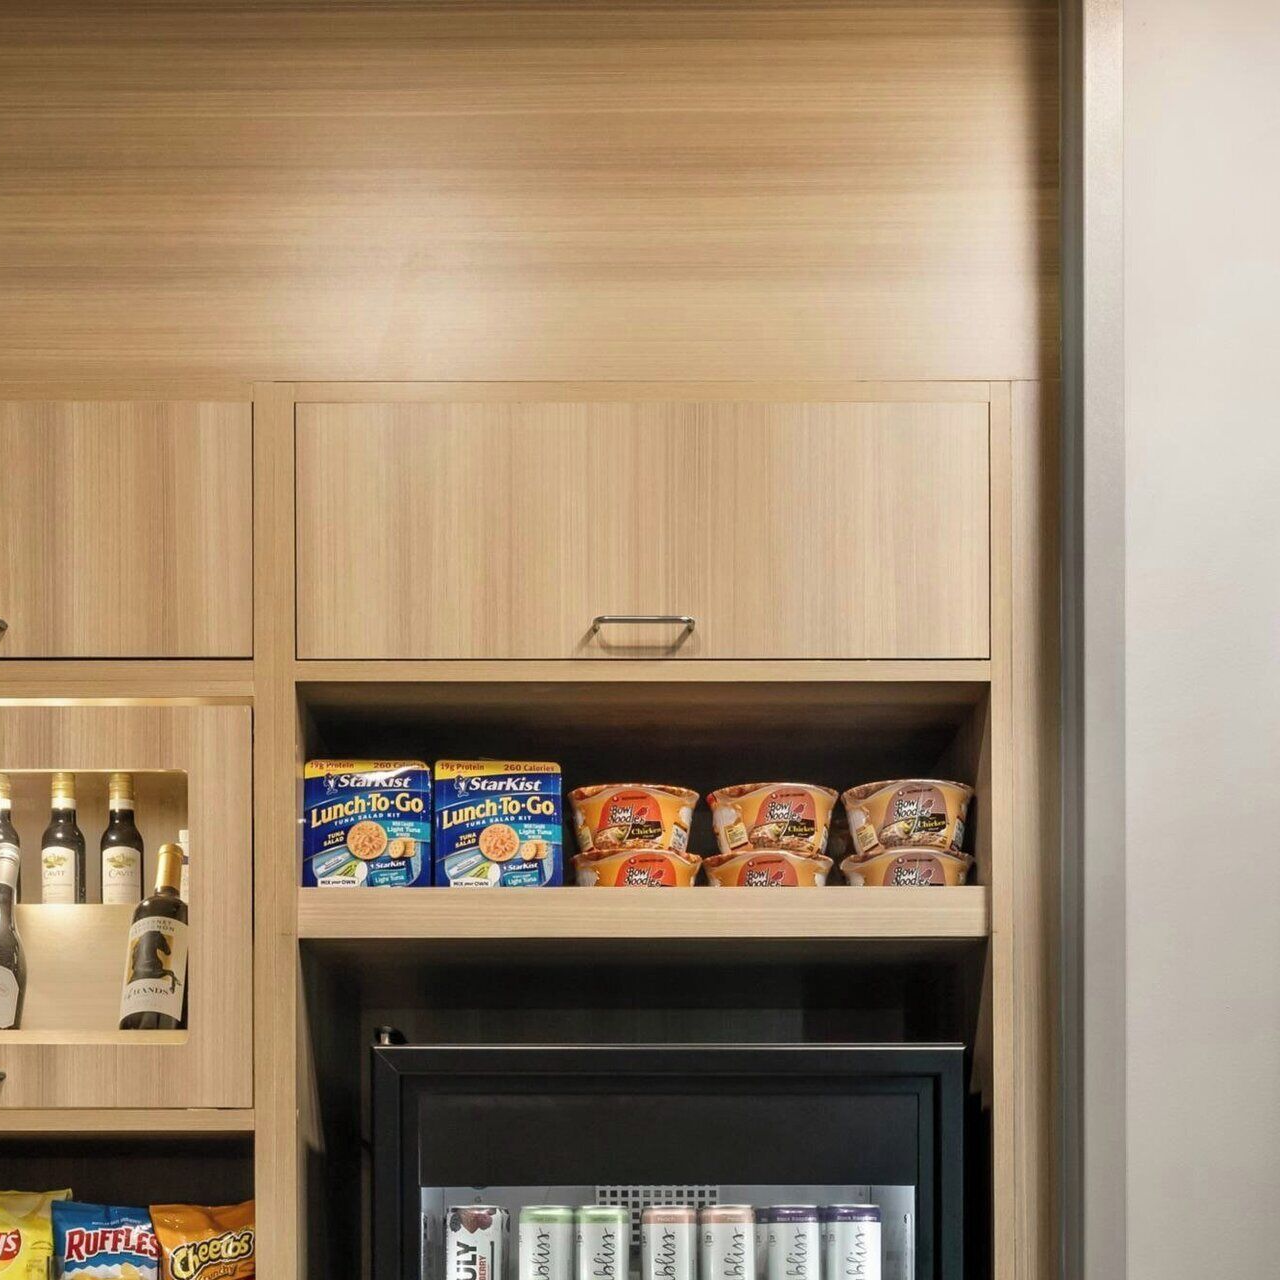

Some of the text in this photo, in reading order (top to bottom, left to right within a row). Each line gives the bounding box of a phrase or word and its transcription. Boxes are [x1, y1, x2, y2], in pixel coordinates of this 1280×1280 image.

[456, 763, 555, 772] Protein 260 Calories
[338, 774, 412, 789] StarKist
[469, 777, 543, 791] StarKist
[334, 817, 355, 826] TUNA
[357, 814, 385, 822] SALAD
[327, 830, 345, 839] TUNA
[459, 832, 477, 841] TUNA
[323, 837, 345, 847] SALAD
[455, 838, 476, 848] SALAD
[375, 861, 406, 869] StarKist
[506, 862, 538, 870] StarKist
[108, 869, 135, 878] CAVIT
[65, 1227, 160, 1262] RUFFLES
[173, 1232, 254, 1280] Cheetos
